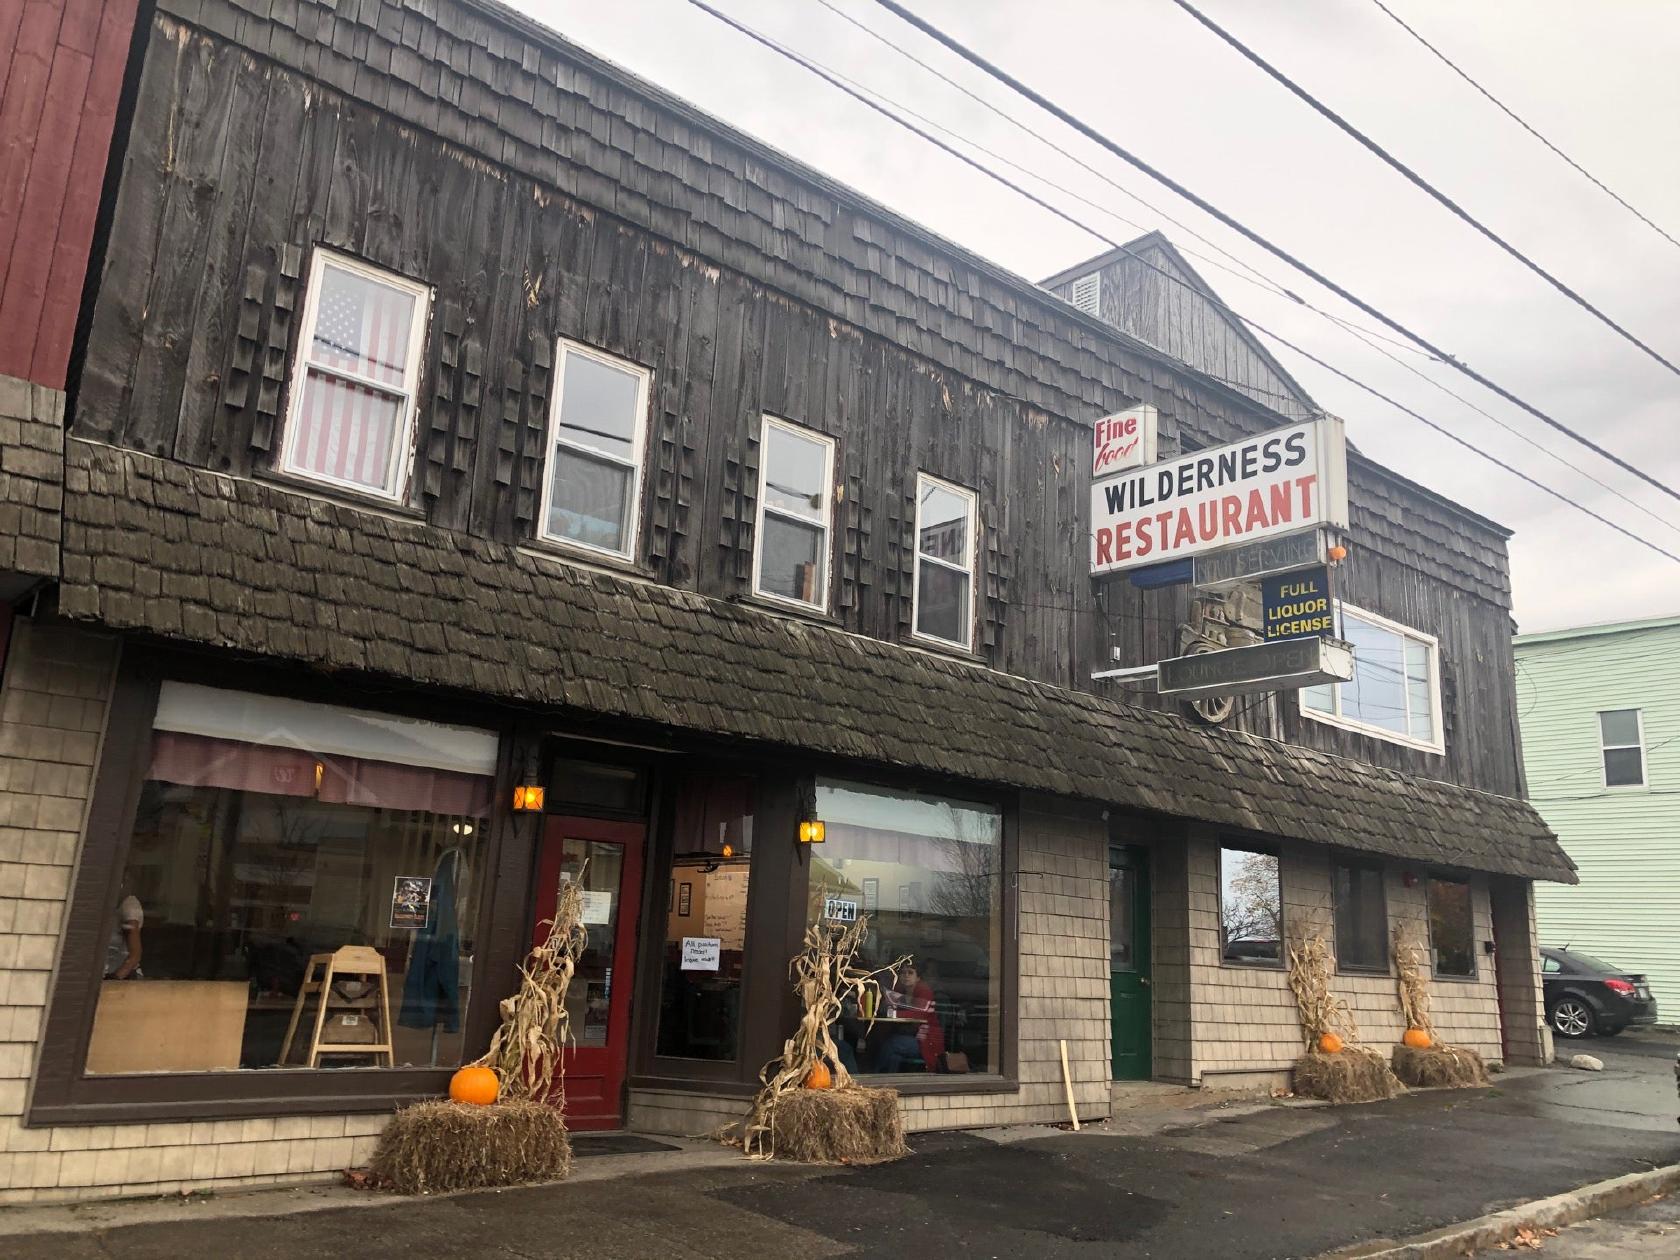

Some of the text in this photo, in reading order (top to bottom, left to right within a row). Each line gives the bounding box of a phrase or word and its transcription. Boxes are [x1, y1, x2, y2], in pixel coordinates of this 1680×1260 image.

[1095, 418, 1137, 449] Fine
[1104, 431, 1306, 515] WILDERNESS
[1096, 473, 1317, 566] RESTAURANT
[1280, 580, 1318, 598] FULL
[1268, 598, 1327, 620] LIQUOR
[1267, 615, 1332, 638] LICENSE
[828, 900, 855, 919] OPEN
